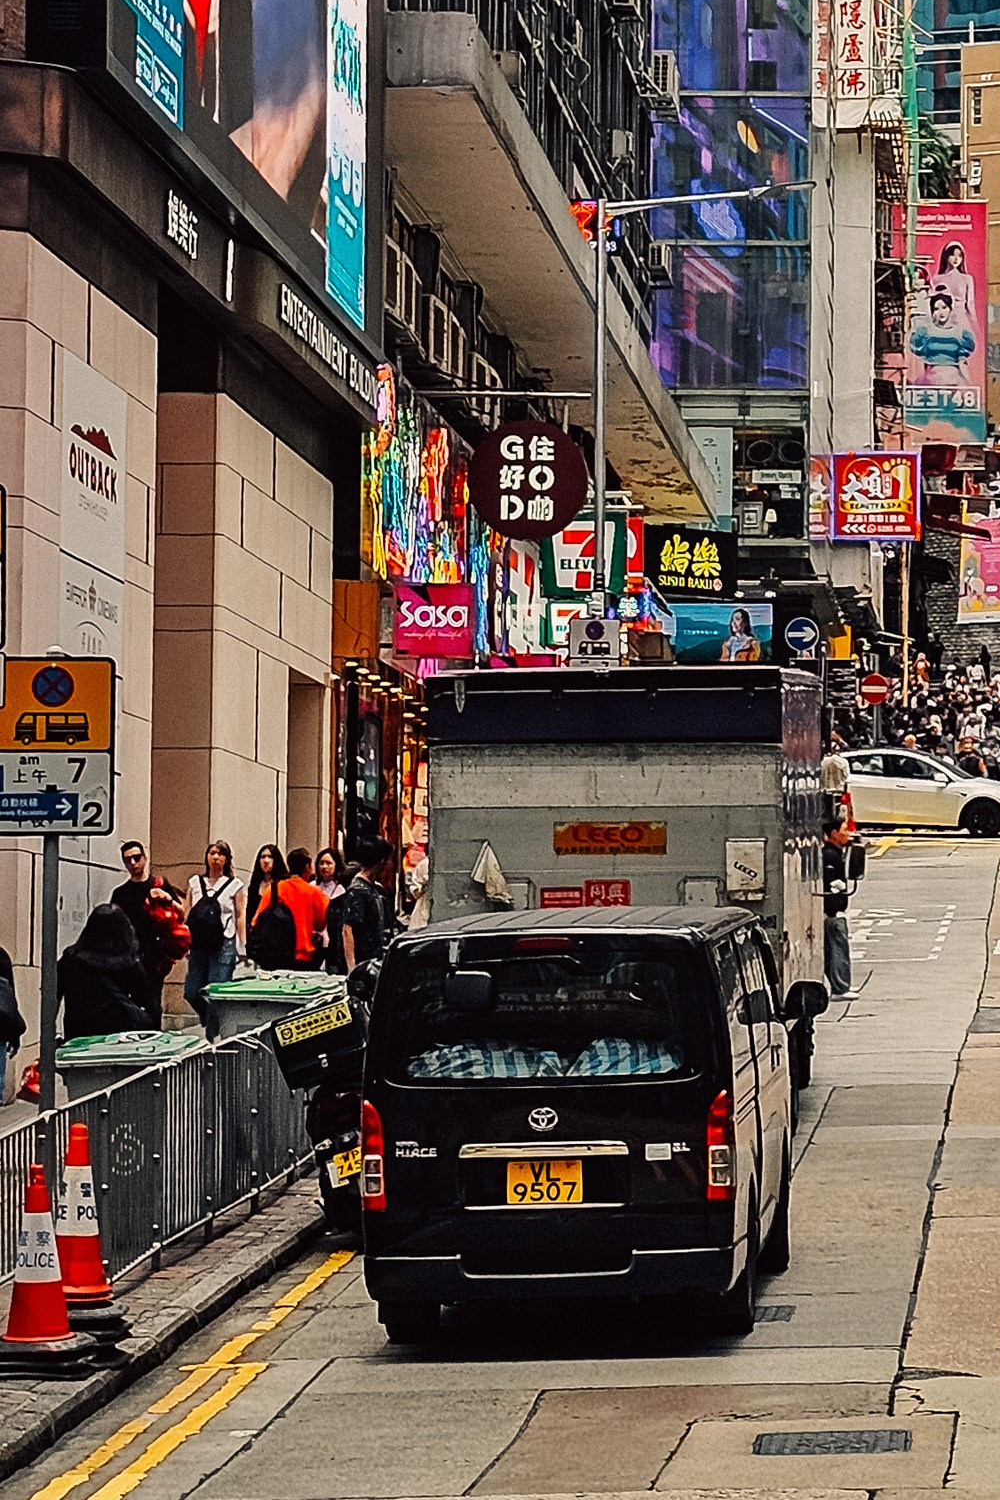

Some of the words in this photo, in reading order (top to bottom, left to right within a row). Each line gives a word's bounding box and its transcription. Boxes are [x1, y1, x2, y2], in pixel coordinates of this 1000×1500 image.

[281, 282, 349, 380] ENTERTAINMENT
[68, 441, 119, 505] OUTBACK
[12, 769, 48, 784] 上午
[19, 756, 40, 765] am
[67, 757, 87, 784] 7
[395, 1147, 438, 1158] HIACE
[529, 1161, 561, 1183] VL
[513, 1181, 578, 1202] 9507
